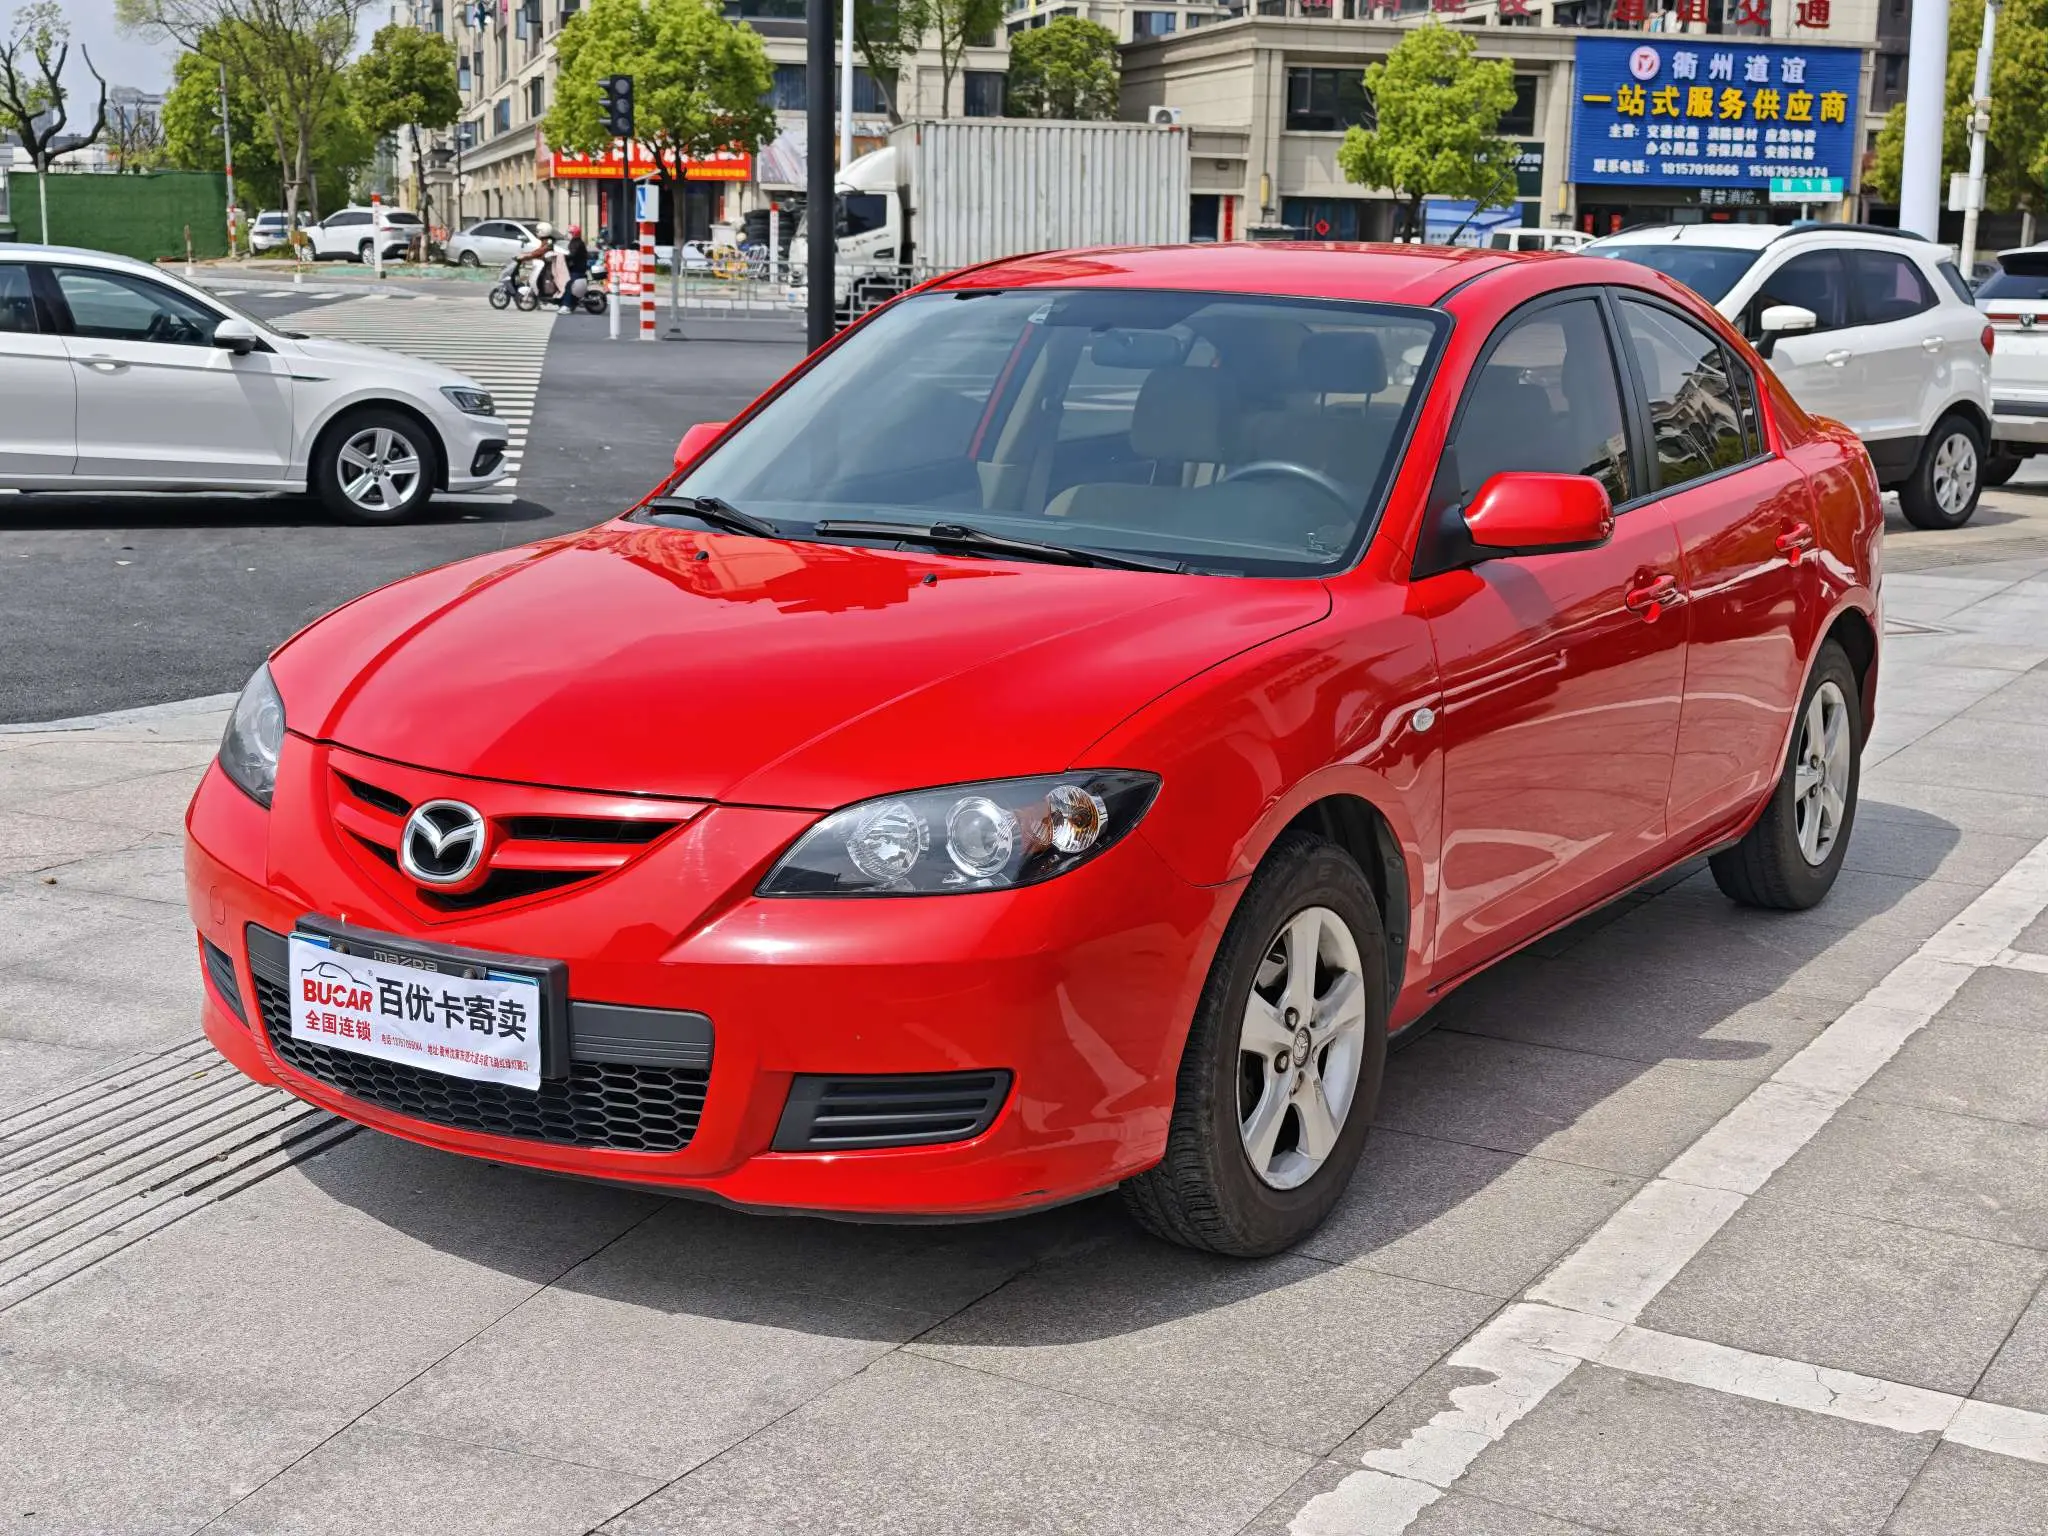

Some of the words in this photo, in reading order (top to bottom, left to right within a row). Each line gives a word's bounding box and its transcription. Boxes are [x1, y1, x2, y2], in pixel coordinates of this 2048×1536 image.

[1672, 51, 1806, 84] 衢州道谊
[1583, 83, 1848, 123] 一站式服务供应商
[303, 978, 373, 1012] BUCAR
[375, 976, 527, 1042] 百优卡寄卖
[305, 1009, 372, 1042] 全国连锁
